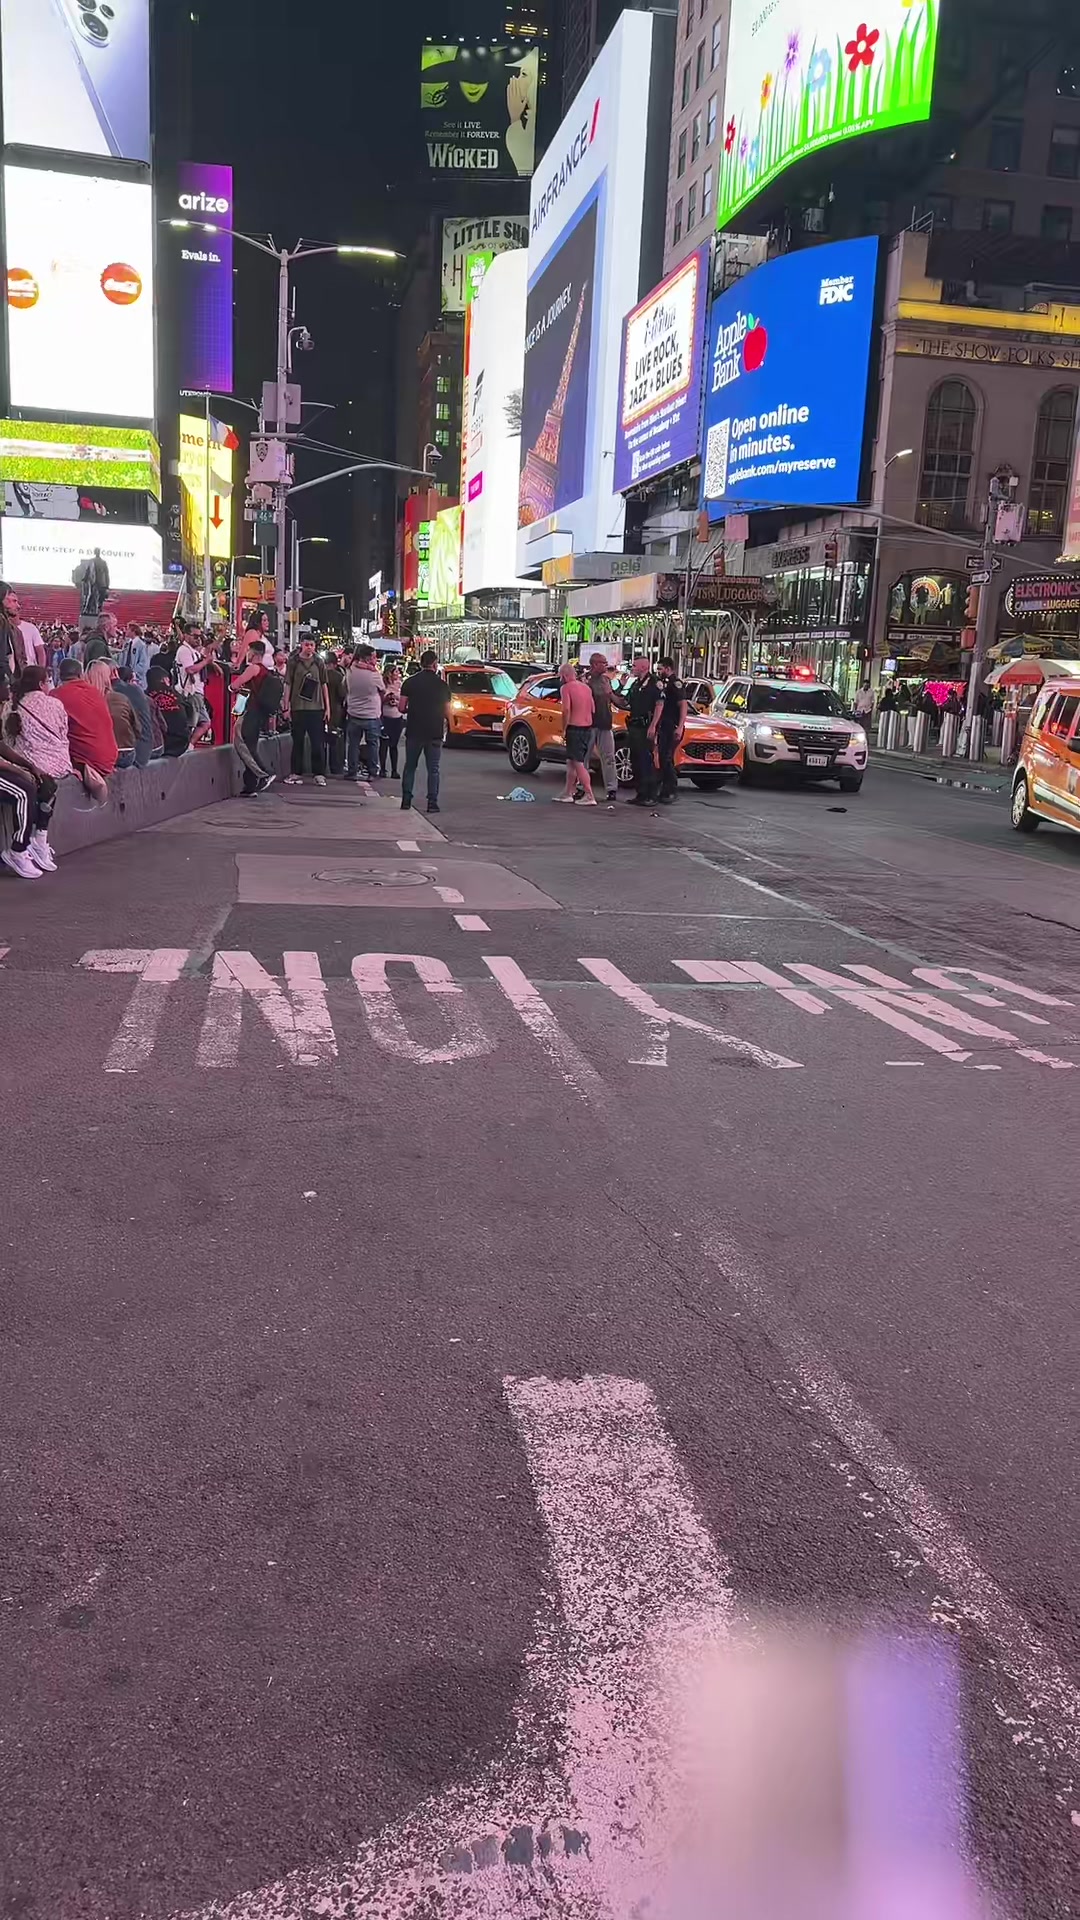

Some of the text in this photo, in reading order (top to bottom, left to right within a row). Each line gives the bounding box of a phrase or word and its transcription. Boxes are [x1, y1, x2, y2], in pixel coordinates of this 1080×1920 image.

[464, 121, 481, 129] LIVE
[466, 131, 500, 139] FOREVER
[179, 191, 229, 213] arize
[453, 220, 500, 250] LITTLE
[181, 249, 221, 262] Evals in.
[820, 276, 854, 288] Member
[819, 283, 854, 306] FDIC
[714, 310, 747, 360] Apple
[634, 330, 679, 381] LIVE ROCK,
[919, 338, 950, 356] THE
[954, 342, 999, 362] SHOW
[1007, 347, 1056, 366] FOLKS
[629, 376, 648, 410] JAZZ
[655, 353, 683, 392] BLUES
[711, 348, 742, 393] Bank
[732, 403, 810, 440] Open online
[730, 433, 796, 464] in minutes.
[728, 457, 837, 485] applebank.com/myreserve
[20, 544, 50, 552] EVERY
[86, 549, 135, 558] DICOVERY
[772, 546, 811, 569] EXPRESS
[717, 583, 764, 600] LUGGAGE
[1014, 581, 1080, 598] ELECTRONICS
[1047, 598, 1080, 609] LUGGAGE
